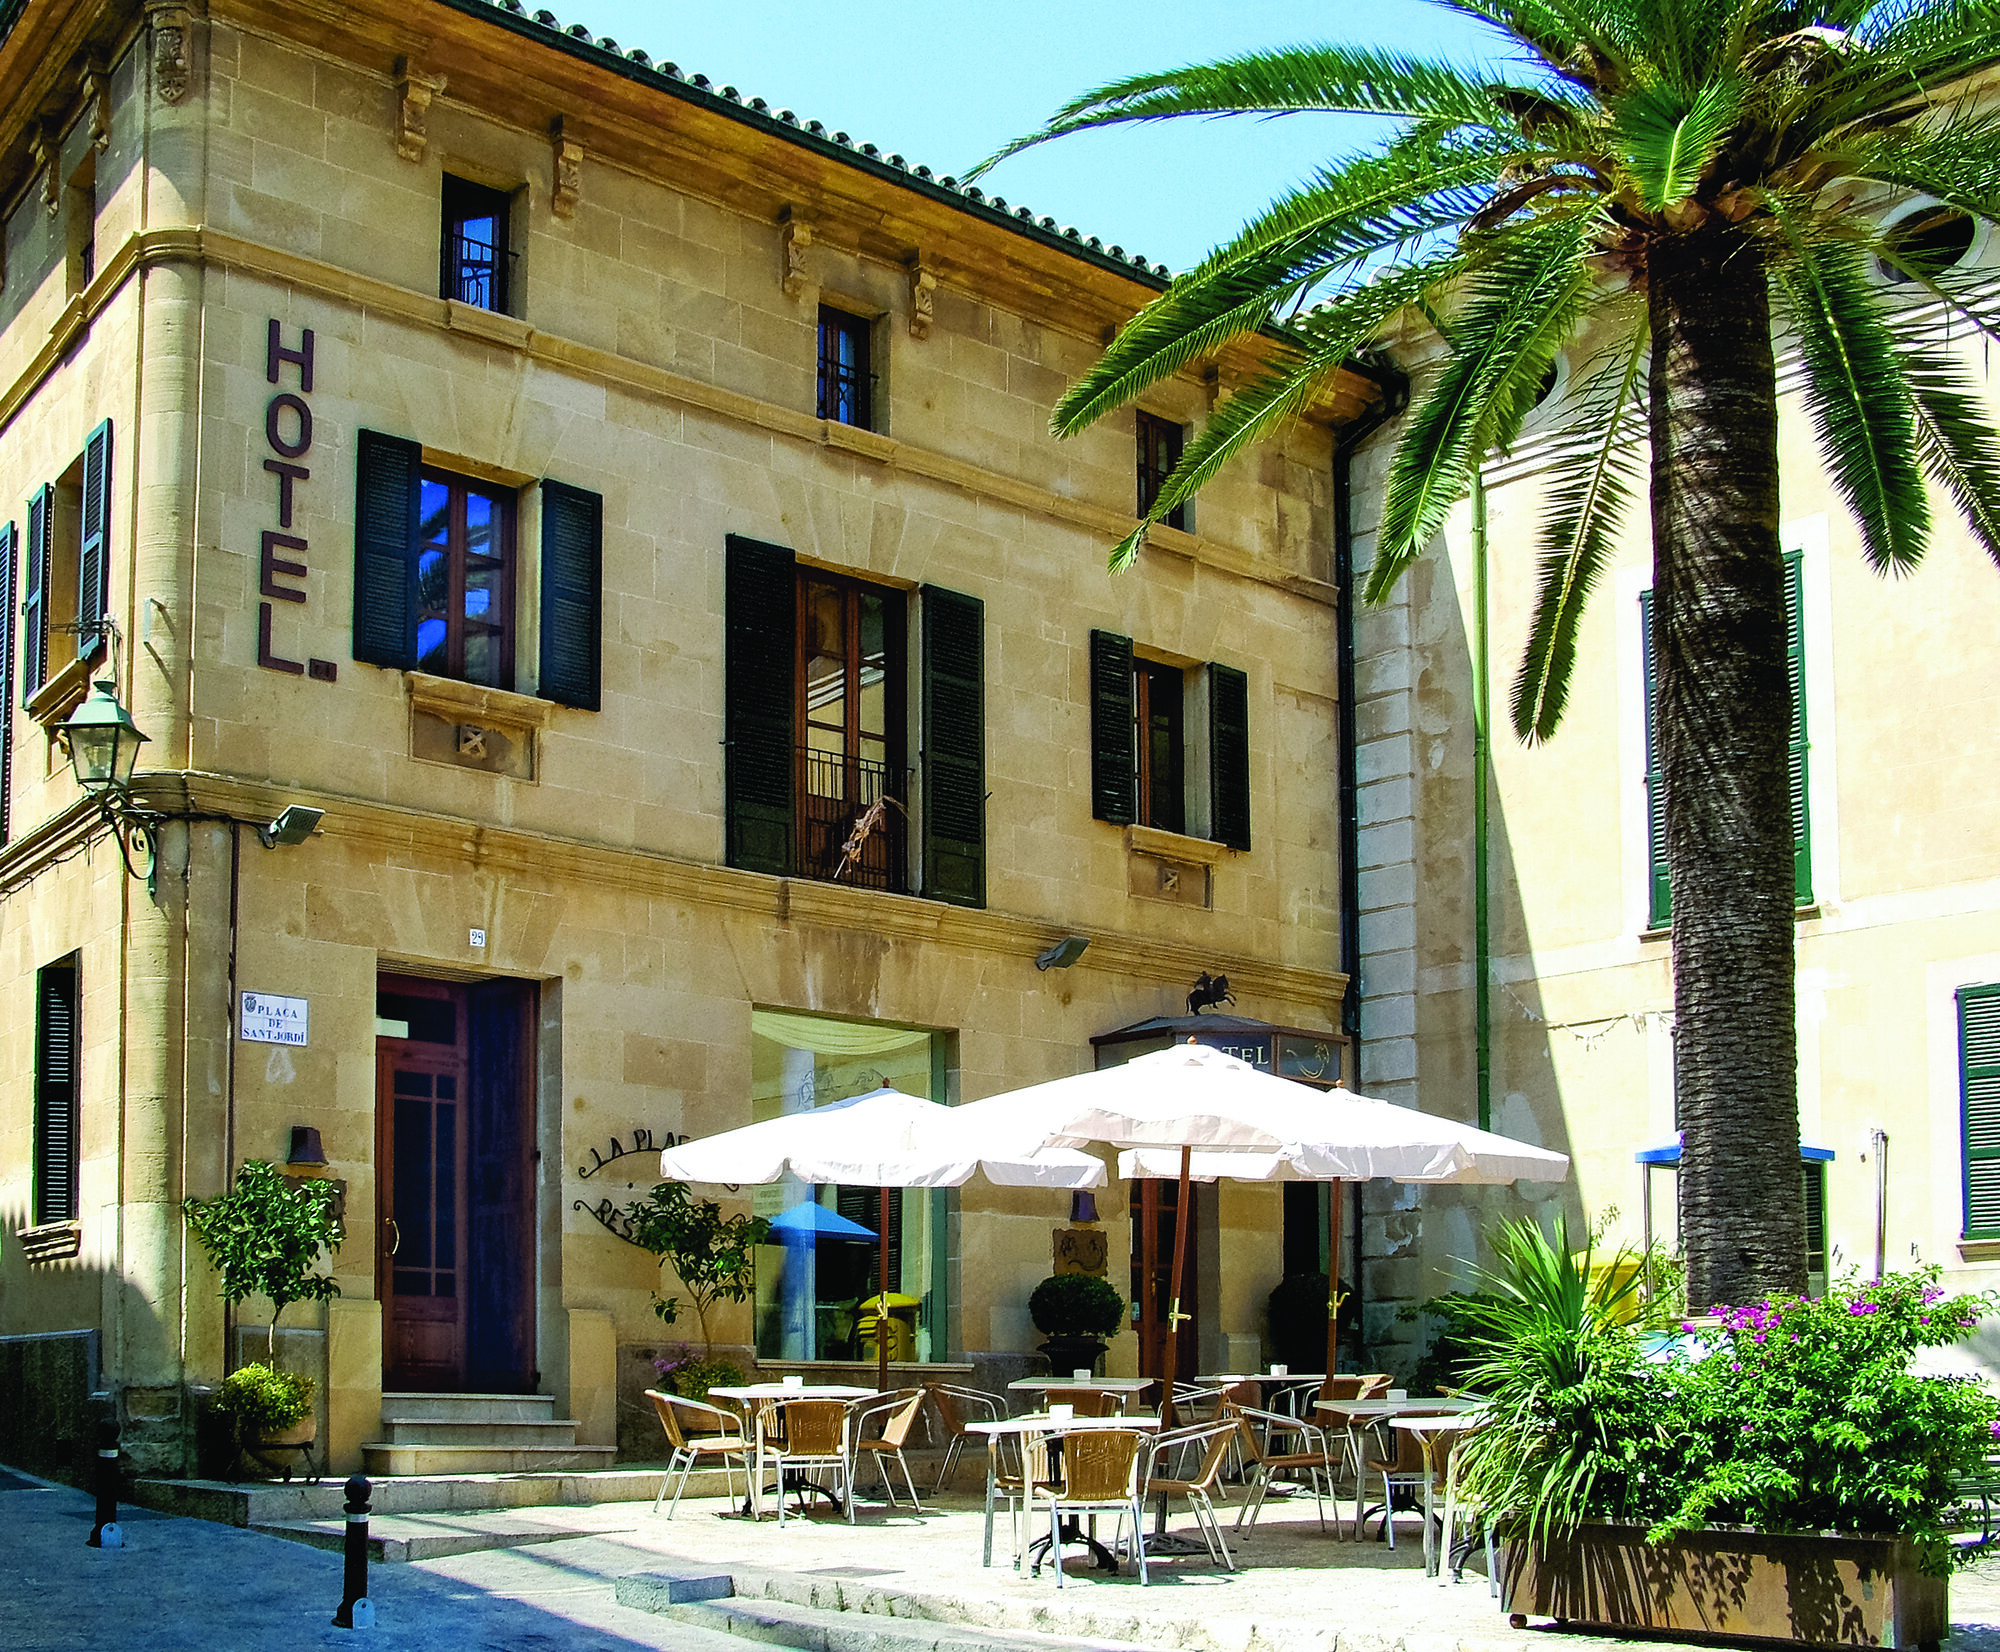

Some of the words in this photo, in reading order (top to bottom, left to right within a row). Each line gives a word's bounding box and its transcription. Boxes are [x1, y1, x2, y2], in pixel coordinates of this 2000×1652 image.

[258, 318, 315, 674] HOTEL
[471, 930, 484, 945] 29
[268, 1018, 283, 1029] DE
[243, 1027, 272, 1040] SANT
[1221, 1045, 1269, 1065] TEL
[590, 1137, 625, 1167] LA
